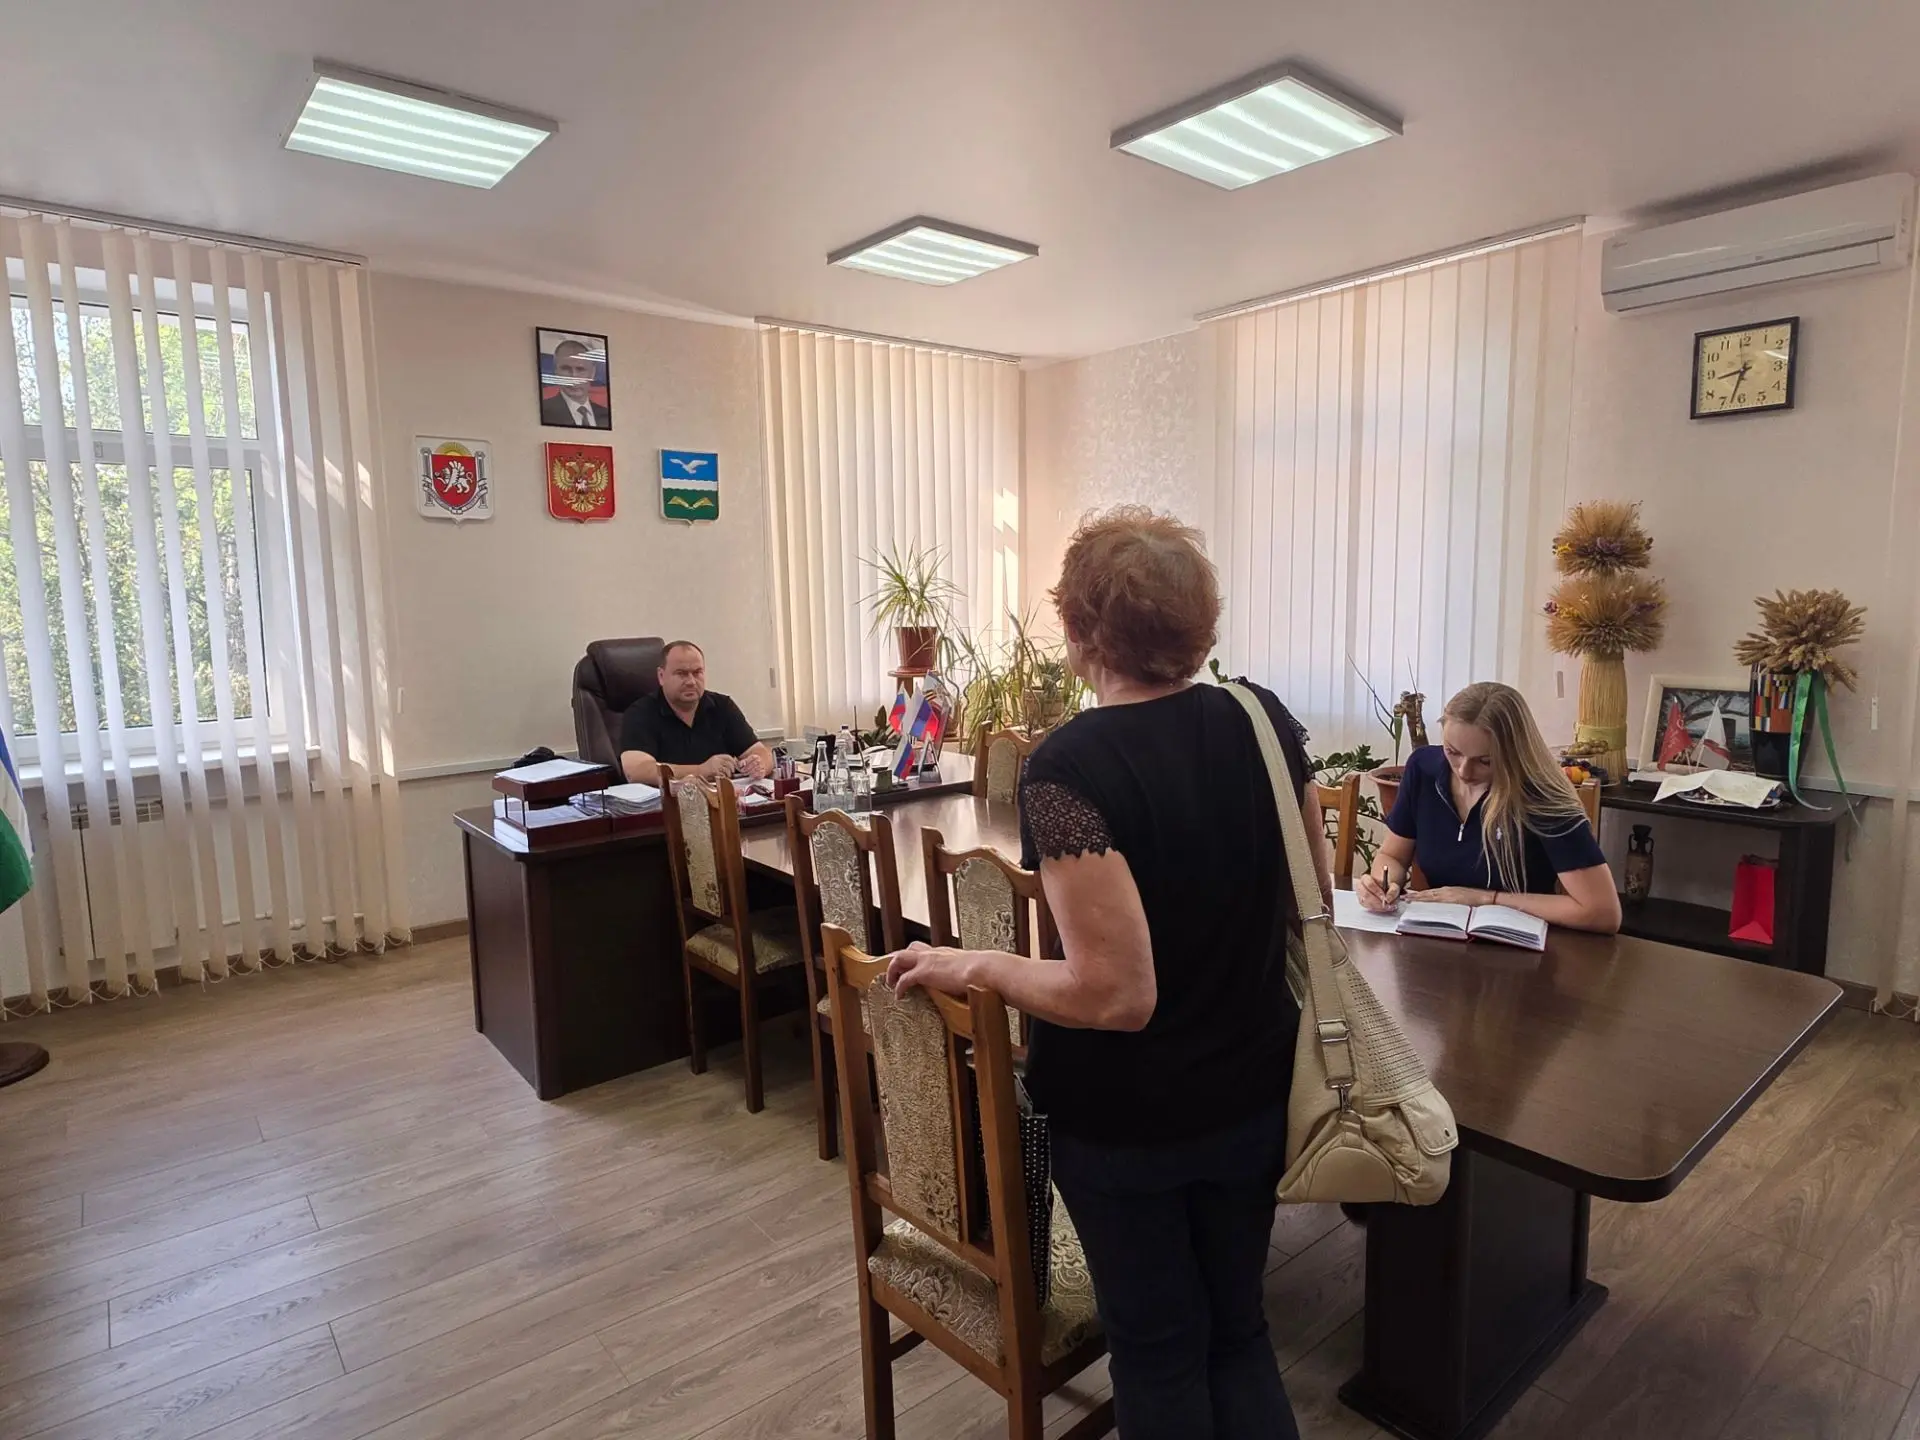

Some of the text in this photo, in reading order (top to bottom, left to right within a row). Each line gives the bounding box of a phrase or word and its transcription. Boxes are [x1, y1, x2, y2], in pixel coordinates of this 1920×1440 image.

[1720, 340, 1730, 351] 11
[1739, 336, 1751, 348] 12
[1775, 339, 1783, 349] 2
[1707, 353, 1719, 363] 10
[1774, 360, 1783, 371] 3
[1707, 370, 1715, 380] 9
[1772, 380, 1780, 391] 4
[1706, 390, 1714, 400] 8
[1737, 393, 1746, 403] 6
[1757, 391, 1766, 401] 5
[1719, 396, 1727, 406] 7
